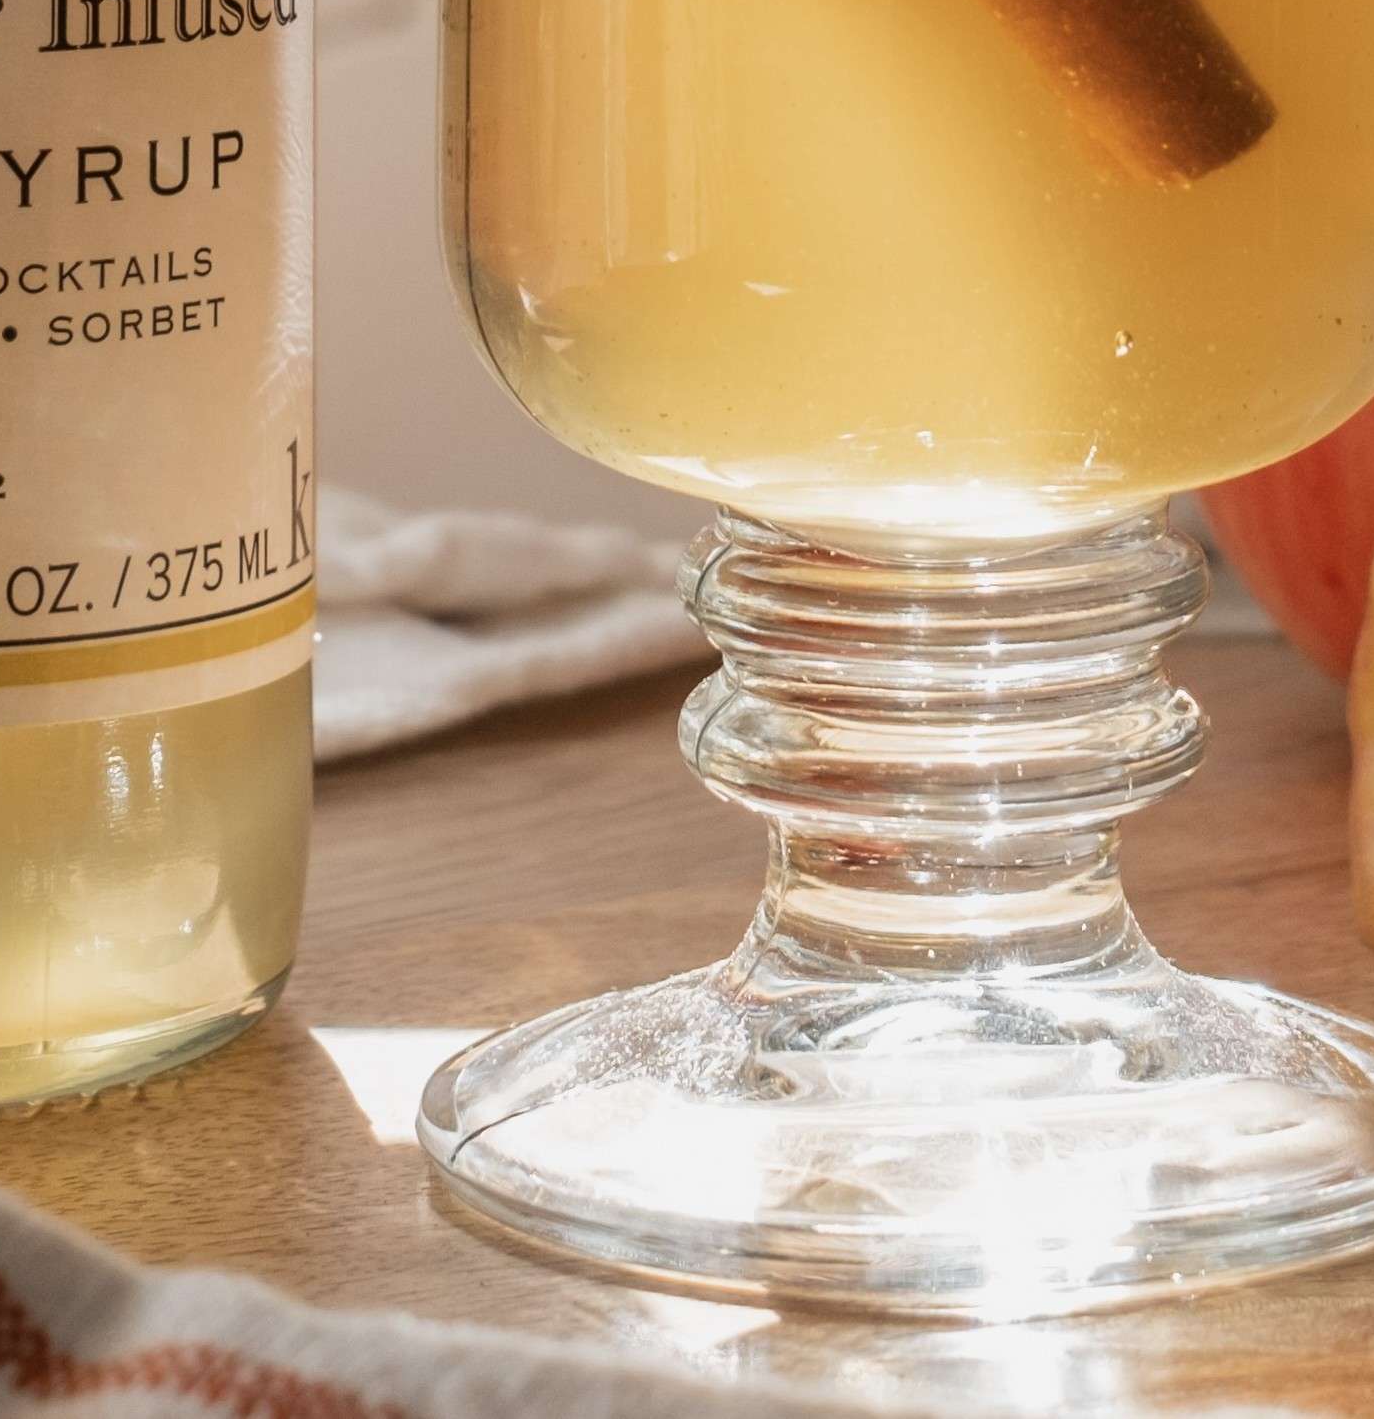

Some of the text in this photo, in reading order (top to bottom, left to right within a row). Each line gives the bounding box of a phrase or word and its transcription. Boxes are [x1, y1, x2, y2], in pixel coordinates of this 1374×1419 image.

[46, 296, 226, 348] SORBET
[111, 554, 133, 609] /
[145, 539, 224, 603] 375
[238, 527, 278, 585] ML
